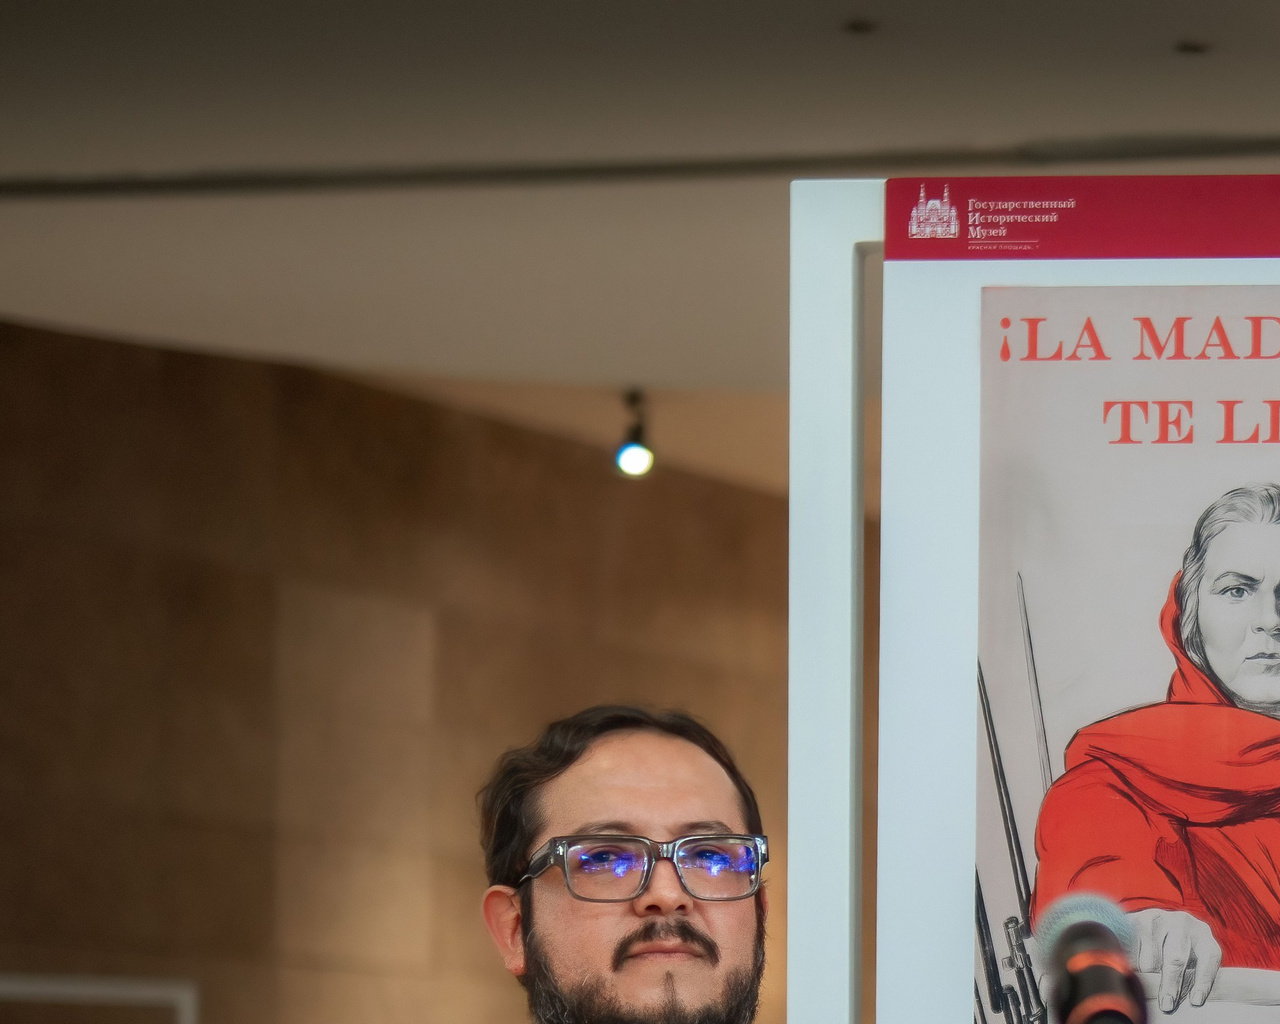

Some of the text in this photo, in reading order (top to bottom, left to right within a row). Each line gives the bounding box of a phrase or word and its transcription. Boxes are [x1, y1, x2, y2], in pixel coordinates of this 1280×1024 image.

[967, 198, 1076, 211] Государственный
[967, 212, 1058, 225] Исторический
[967, 226, 1007, 239] Музей
[999, 315, 1111, 362] ¡LA
[1103, 400, 1195, 446] TE
